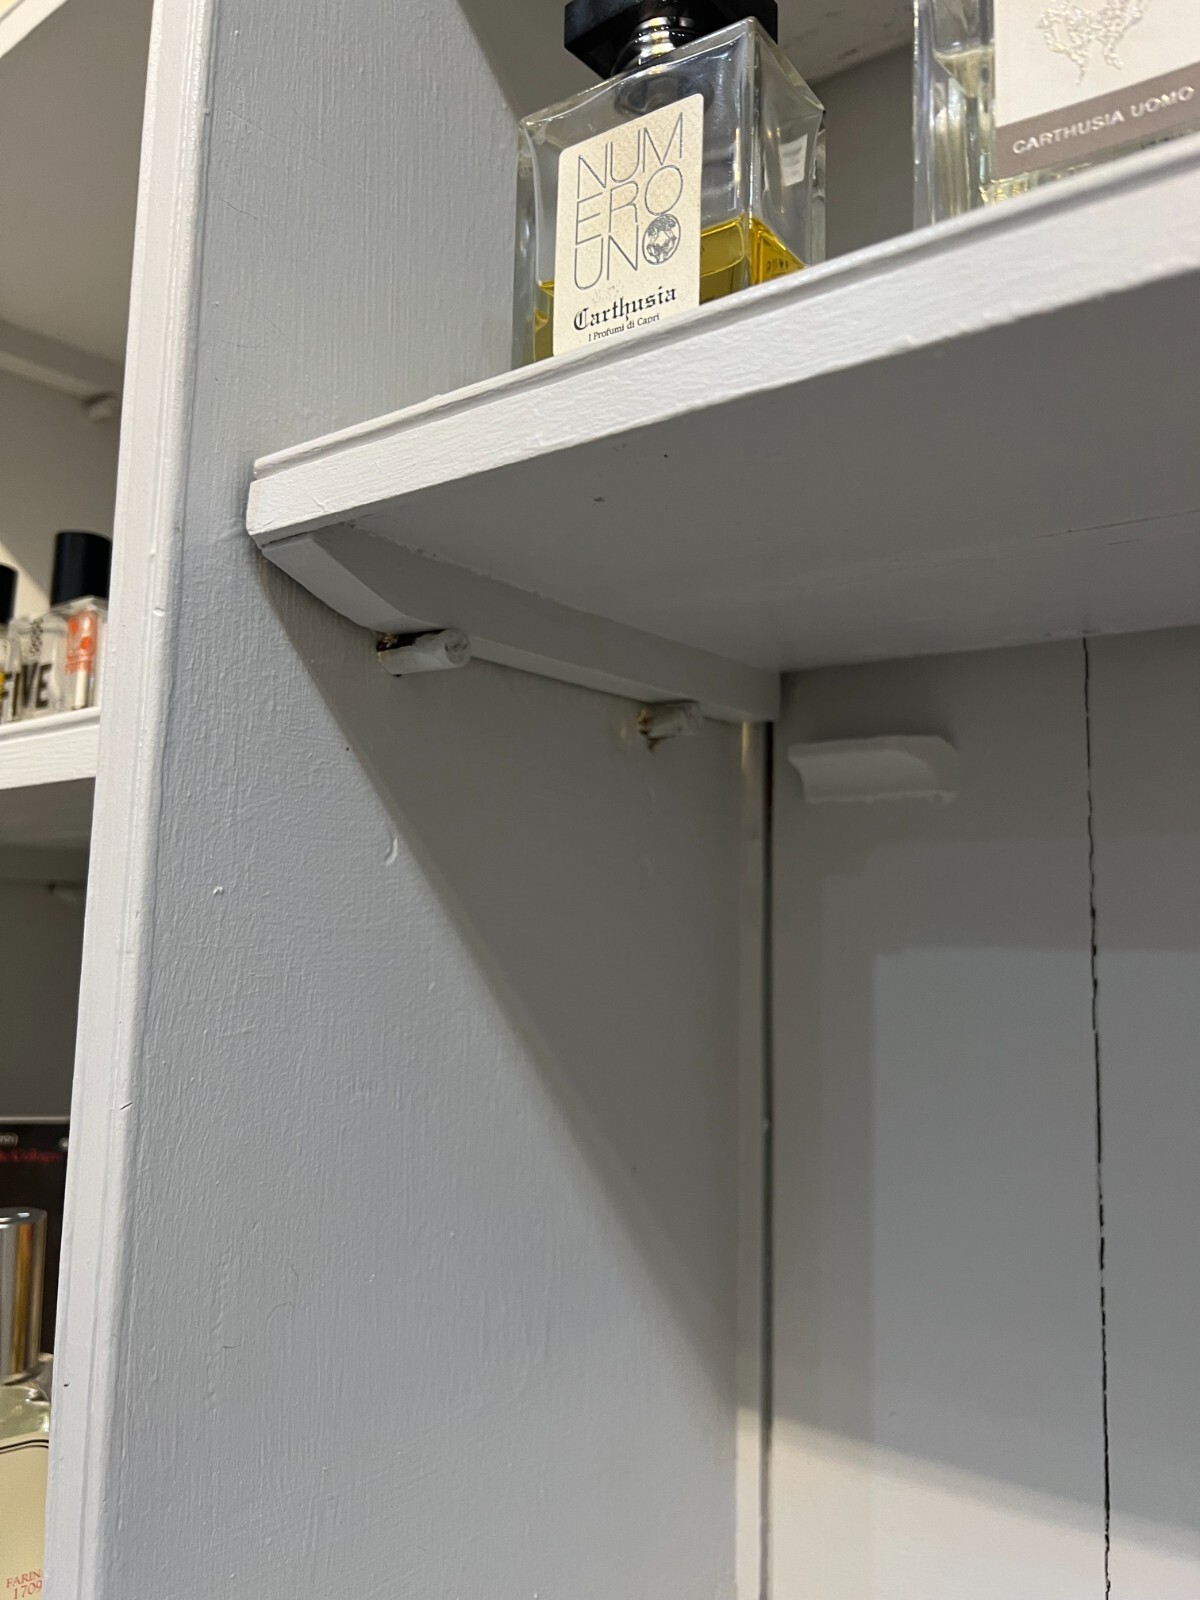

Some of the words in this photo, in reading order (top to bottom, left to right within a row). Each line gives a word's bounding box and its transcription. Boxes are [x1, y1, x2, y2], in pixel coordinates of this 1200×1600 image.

[1012, 109, 1126, 155] CARTHUSIA
[1130, 85, 1196, 118] UOMO
[576, 111, 684, 200] NUM
[575, 164, 684, 246] ERO
[573, 285, 677, 331] Carthusia
[593, 324, 625, 341] Profumi
[626, 320, 635, 330] di
[637, 312, 660, 327] Capri
[14, 1579, 43, 1600] 1709
